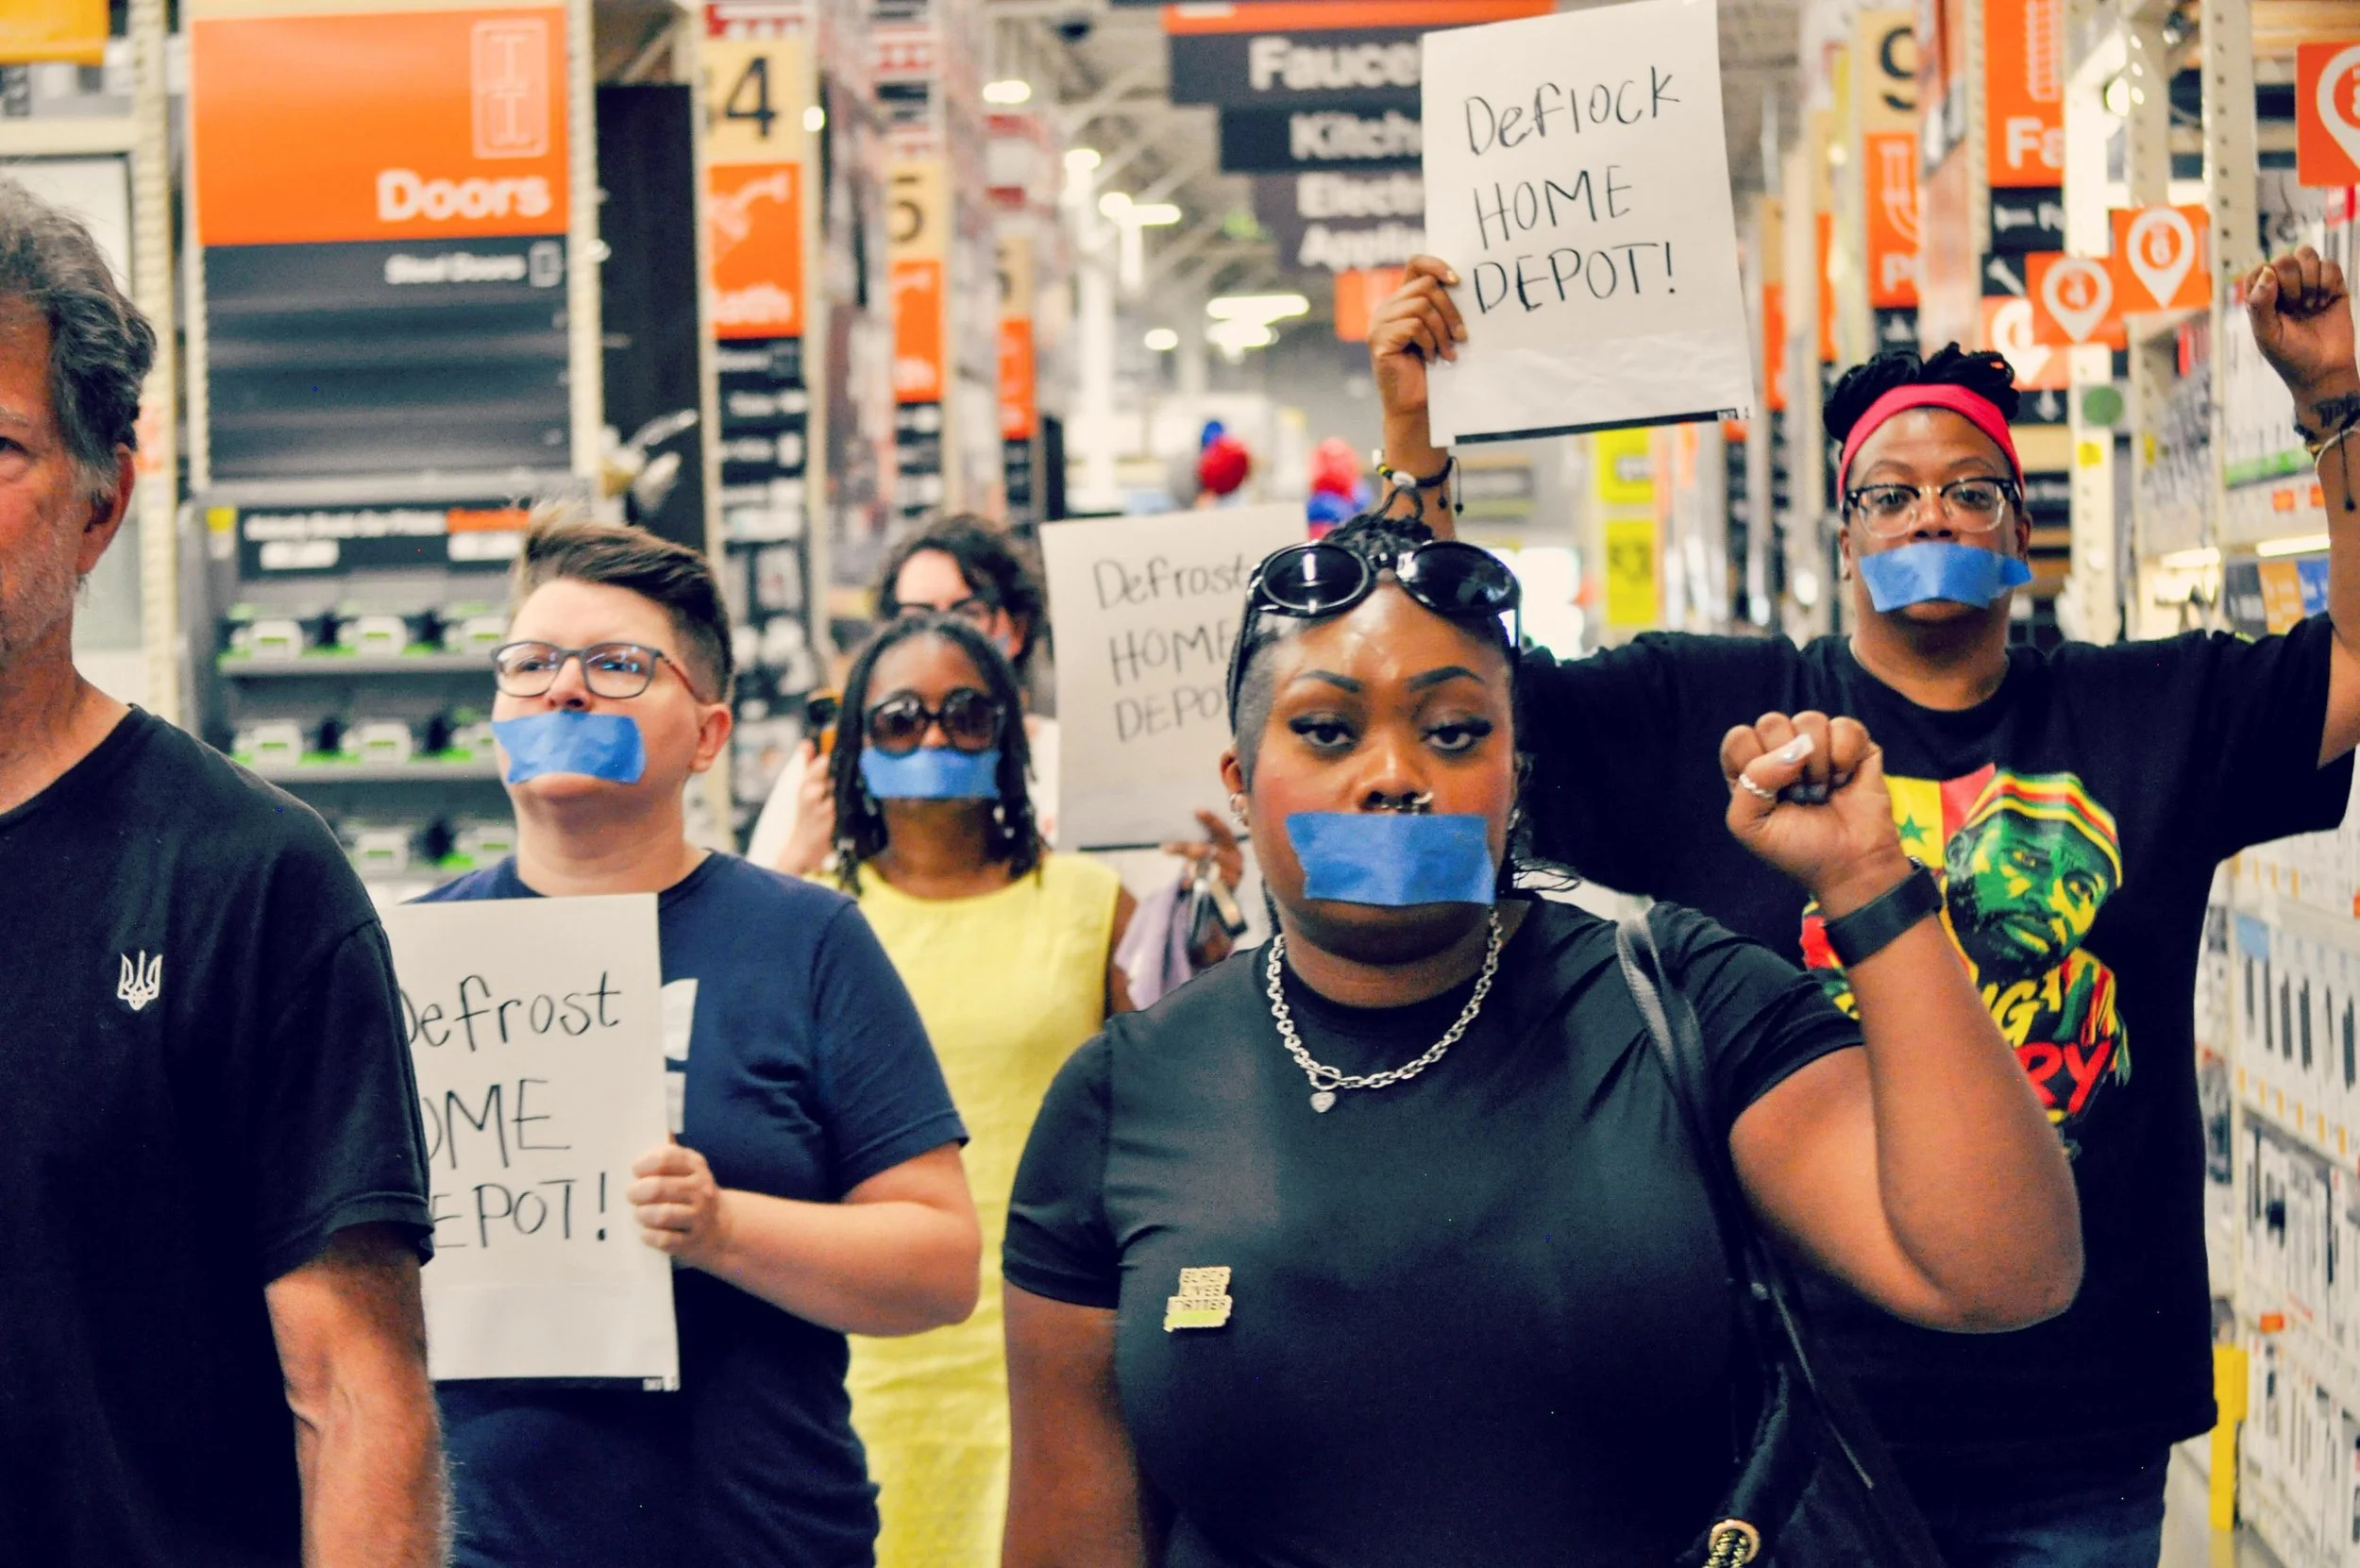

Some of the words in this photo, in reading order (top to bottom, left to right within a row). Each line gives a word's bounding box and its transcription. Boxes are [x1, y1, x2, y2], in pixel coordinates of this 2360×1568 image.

[725, 55, 777, 139] 4
[376, 168, 551, 223] Doors
[1474, 163, 1632, 251] HOME
[1473, 241, 1676, 314] DEPOT!
[1108, 618, 1233, 686] HOME
